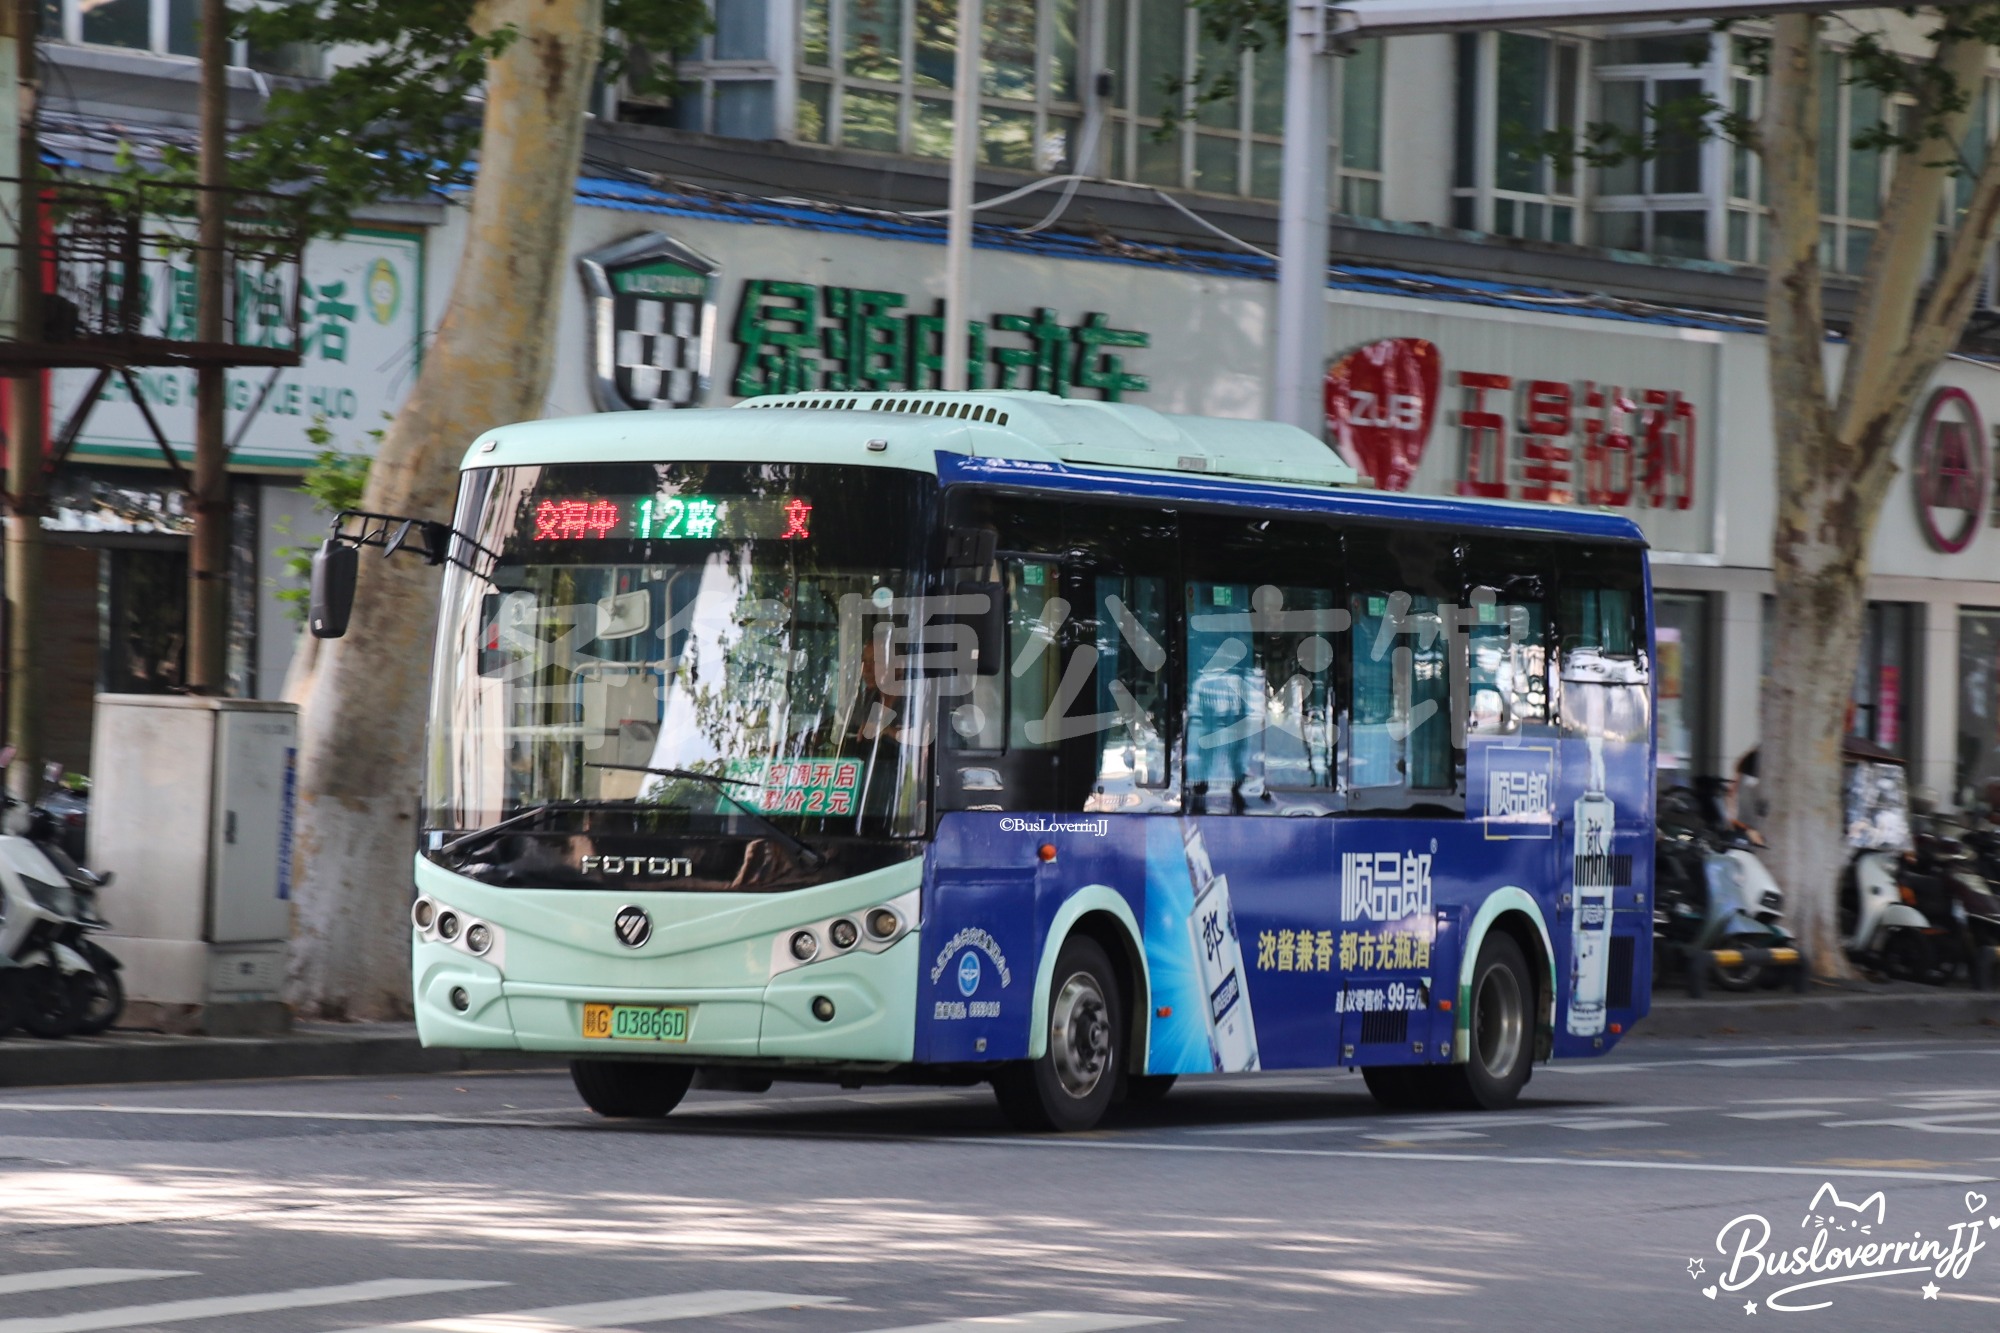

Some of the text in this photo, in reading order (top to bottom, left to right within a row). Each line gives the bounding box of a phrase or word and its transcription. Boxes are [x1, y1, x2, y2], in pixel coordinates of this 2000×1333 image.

[769, 763, 856, 788] 空调开启
[1490, 770, 1548, 816] 顺品郎
[581, 855, 694, 877] FOTON
[1340, 849, 1432, 922] 顺品郎
[1257, 929, 1431, 972] 浓酱兼香 都市光瓶酒
[616, 1010, 685, 1037] 03866D
